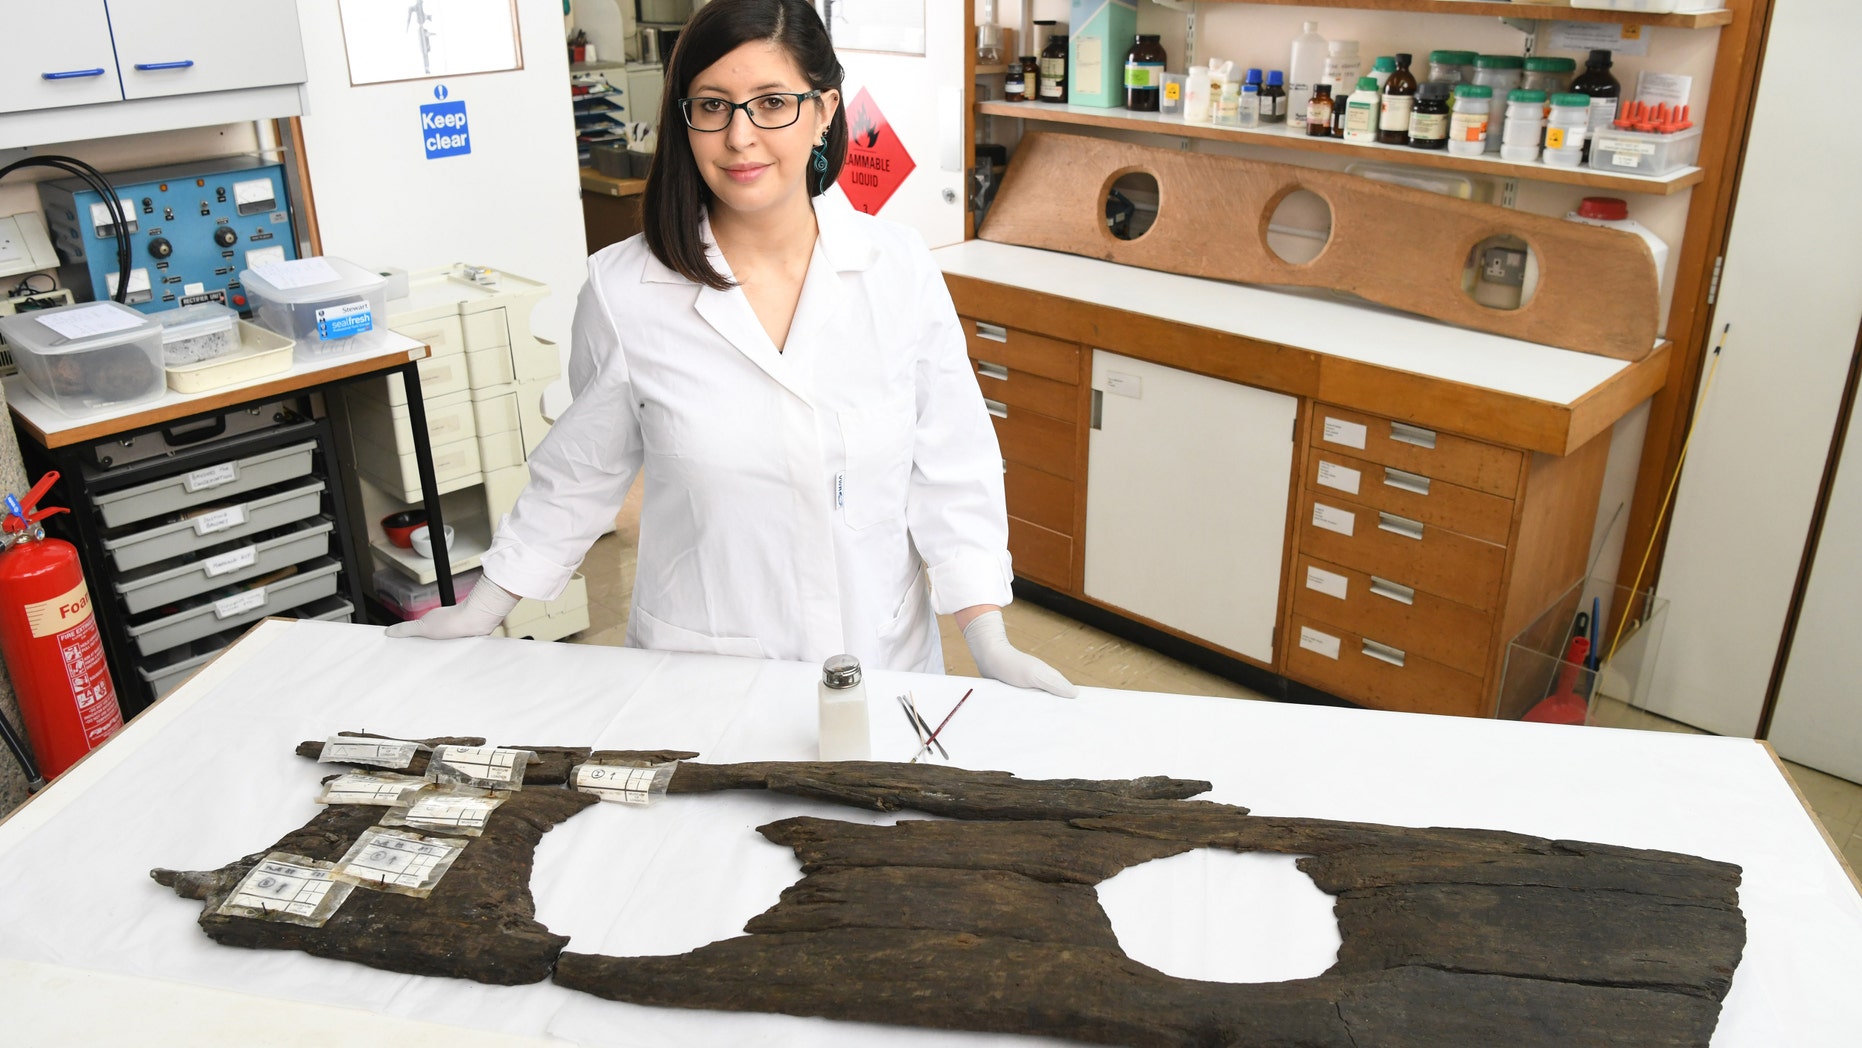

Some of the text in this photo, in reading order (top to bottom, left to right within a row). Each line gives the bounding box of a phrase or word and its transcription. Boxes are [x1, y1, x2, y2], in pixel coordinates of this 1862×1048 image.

[422, 112, 466, 130] Keep
[426, 133, 467, 151] clear
[846, 153, 890, 172] AMMABLE
[852, 171, 878, 187] LIQUID
[183, 294, 209, 305] RECTIFIER
[342, 303, 368, 313] Stewart
[332, 314, 370, 329] sealfresh
